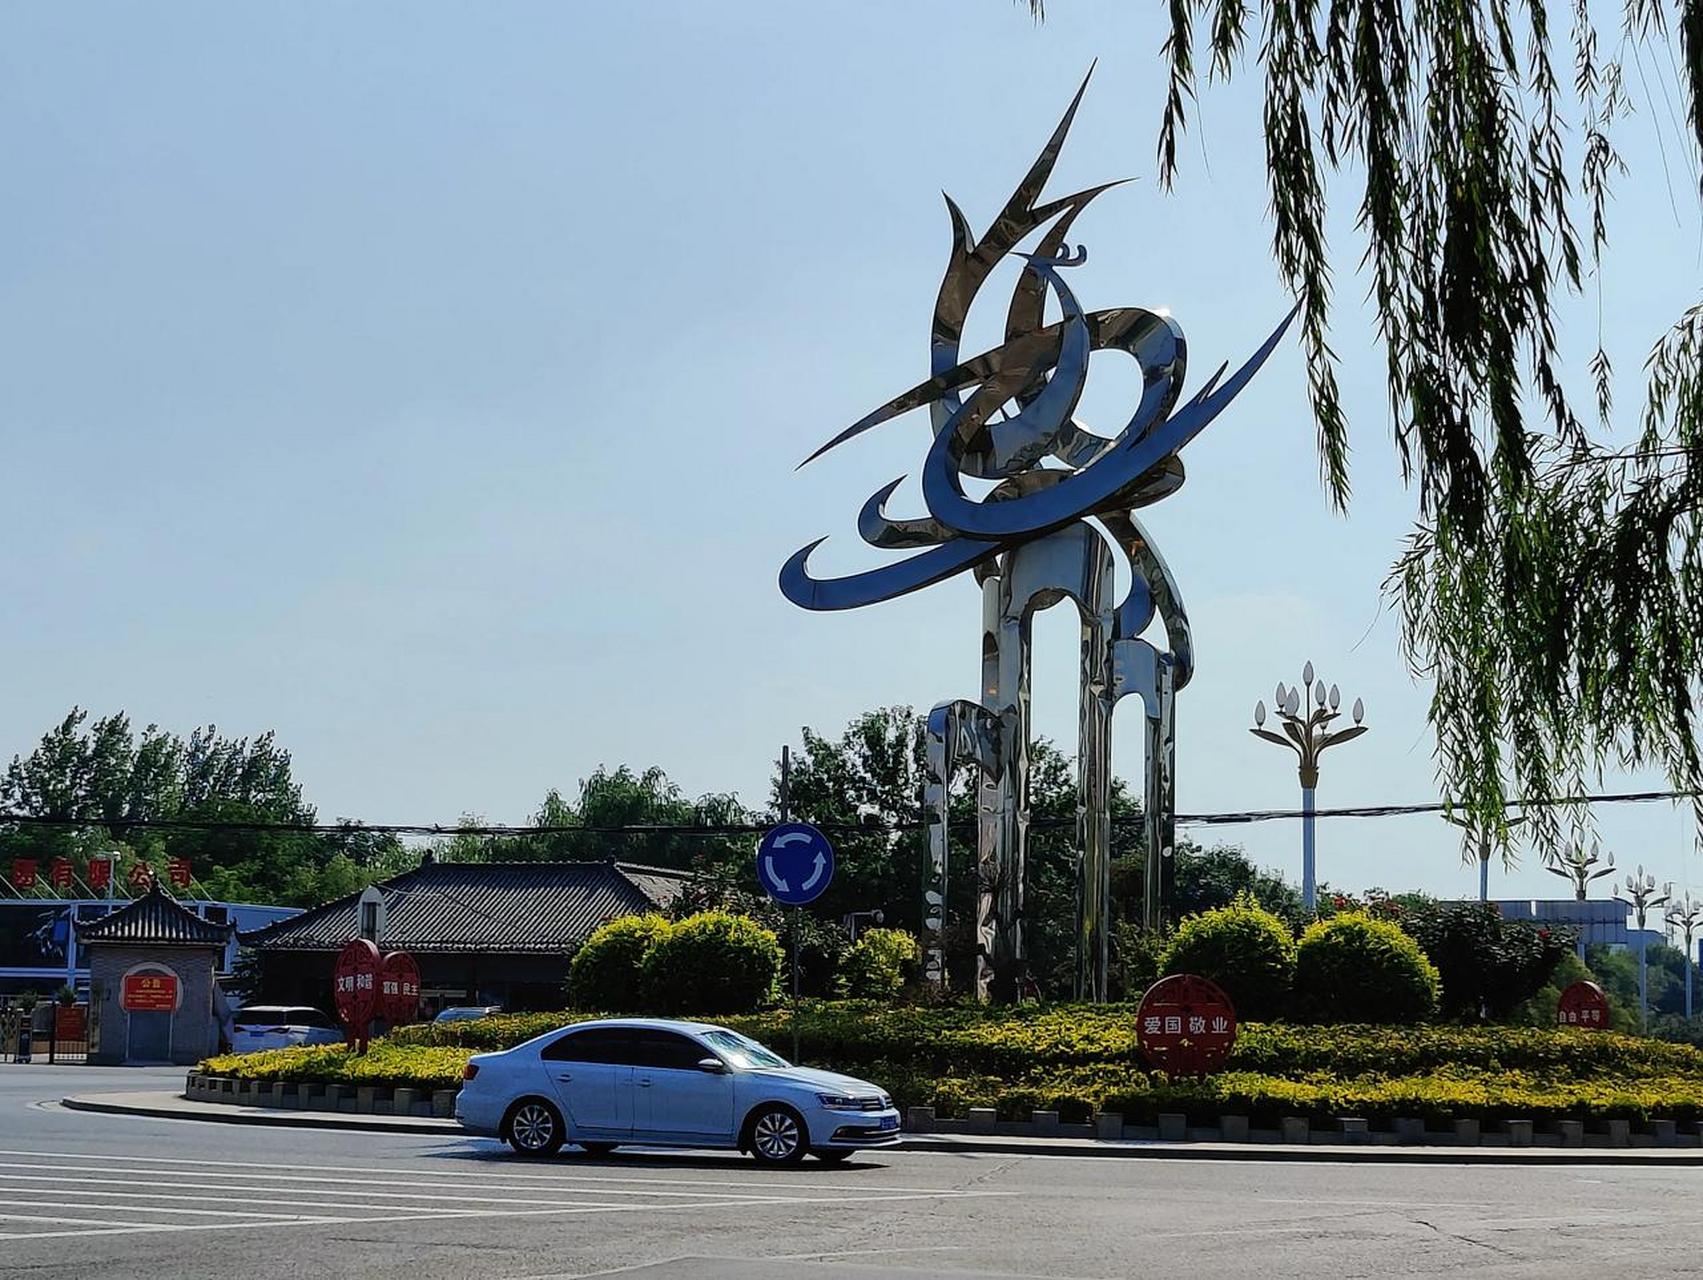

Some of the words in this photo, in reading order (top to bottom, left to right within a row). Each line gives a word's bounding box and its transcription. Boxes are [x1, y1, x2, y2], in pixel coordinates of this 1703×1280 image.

[337, 973, 373, 992] 文明和谐
[1144, 1016, 1229, 1034] 爱国敬业
